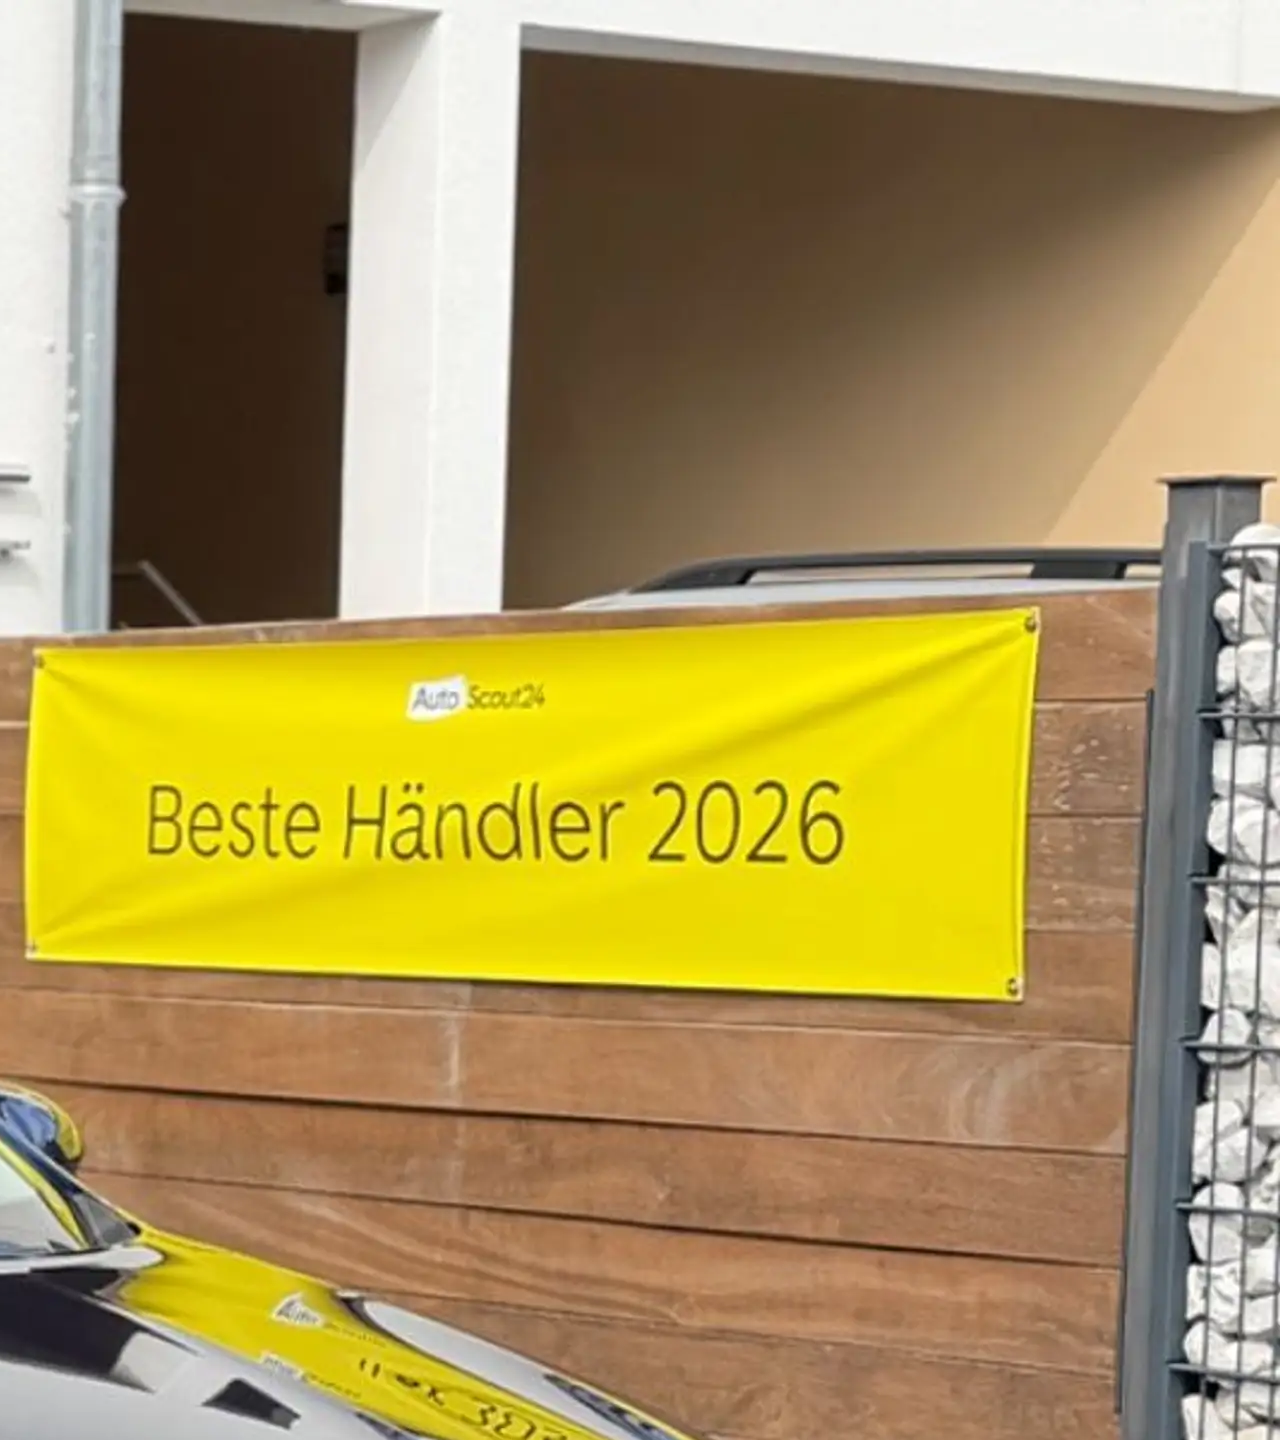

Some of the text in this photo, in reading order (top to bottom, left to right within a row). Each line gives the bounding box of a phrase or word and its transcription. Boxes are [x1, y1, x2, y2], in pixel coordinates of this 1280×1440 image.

[412, 682, 545, 711] Auto Scout24
[147, 779, 844, 865] Beste Händler 2026
